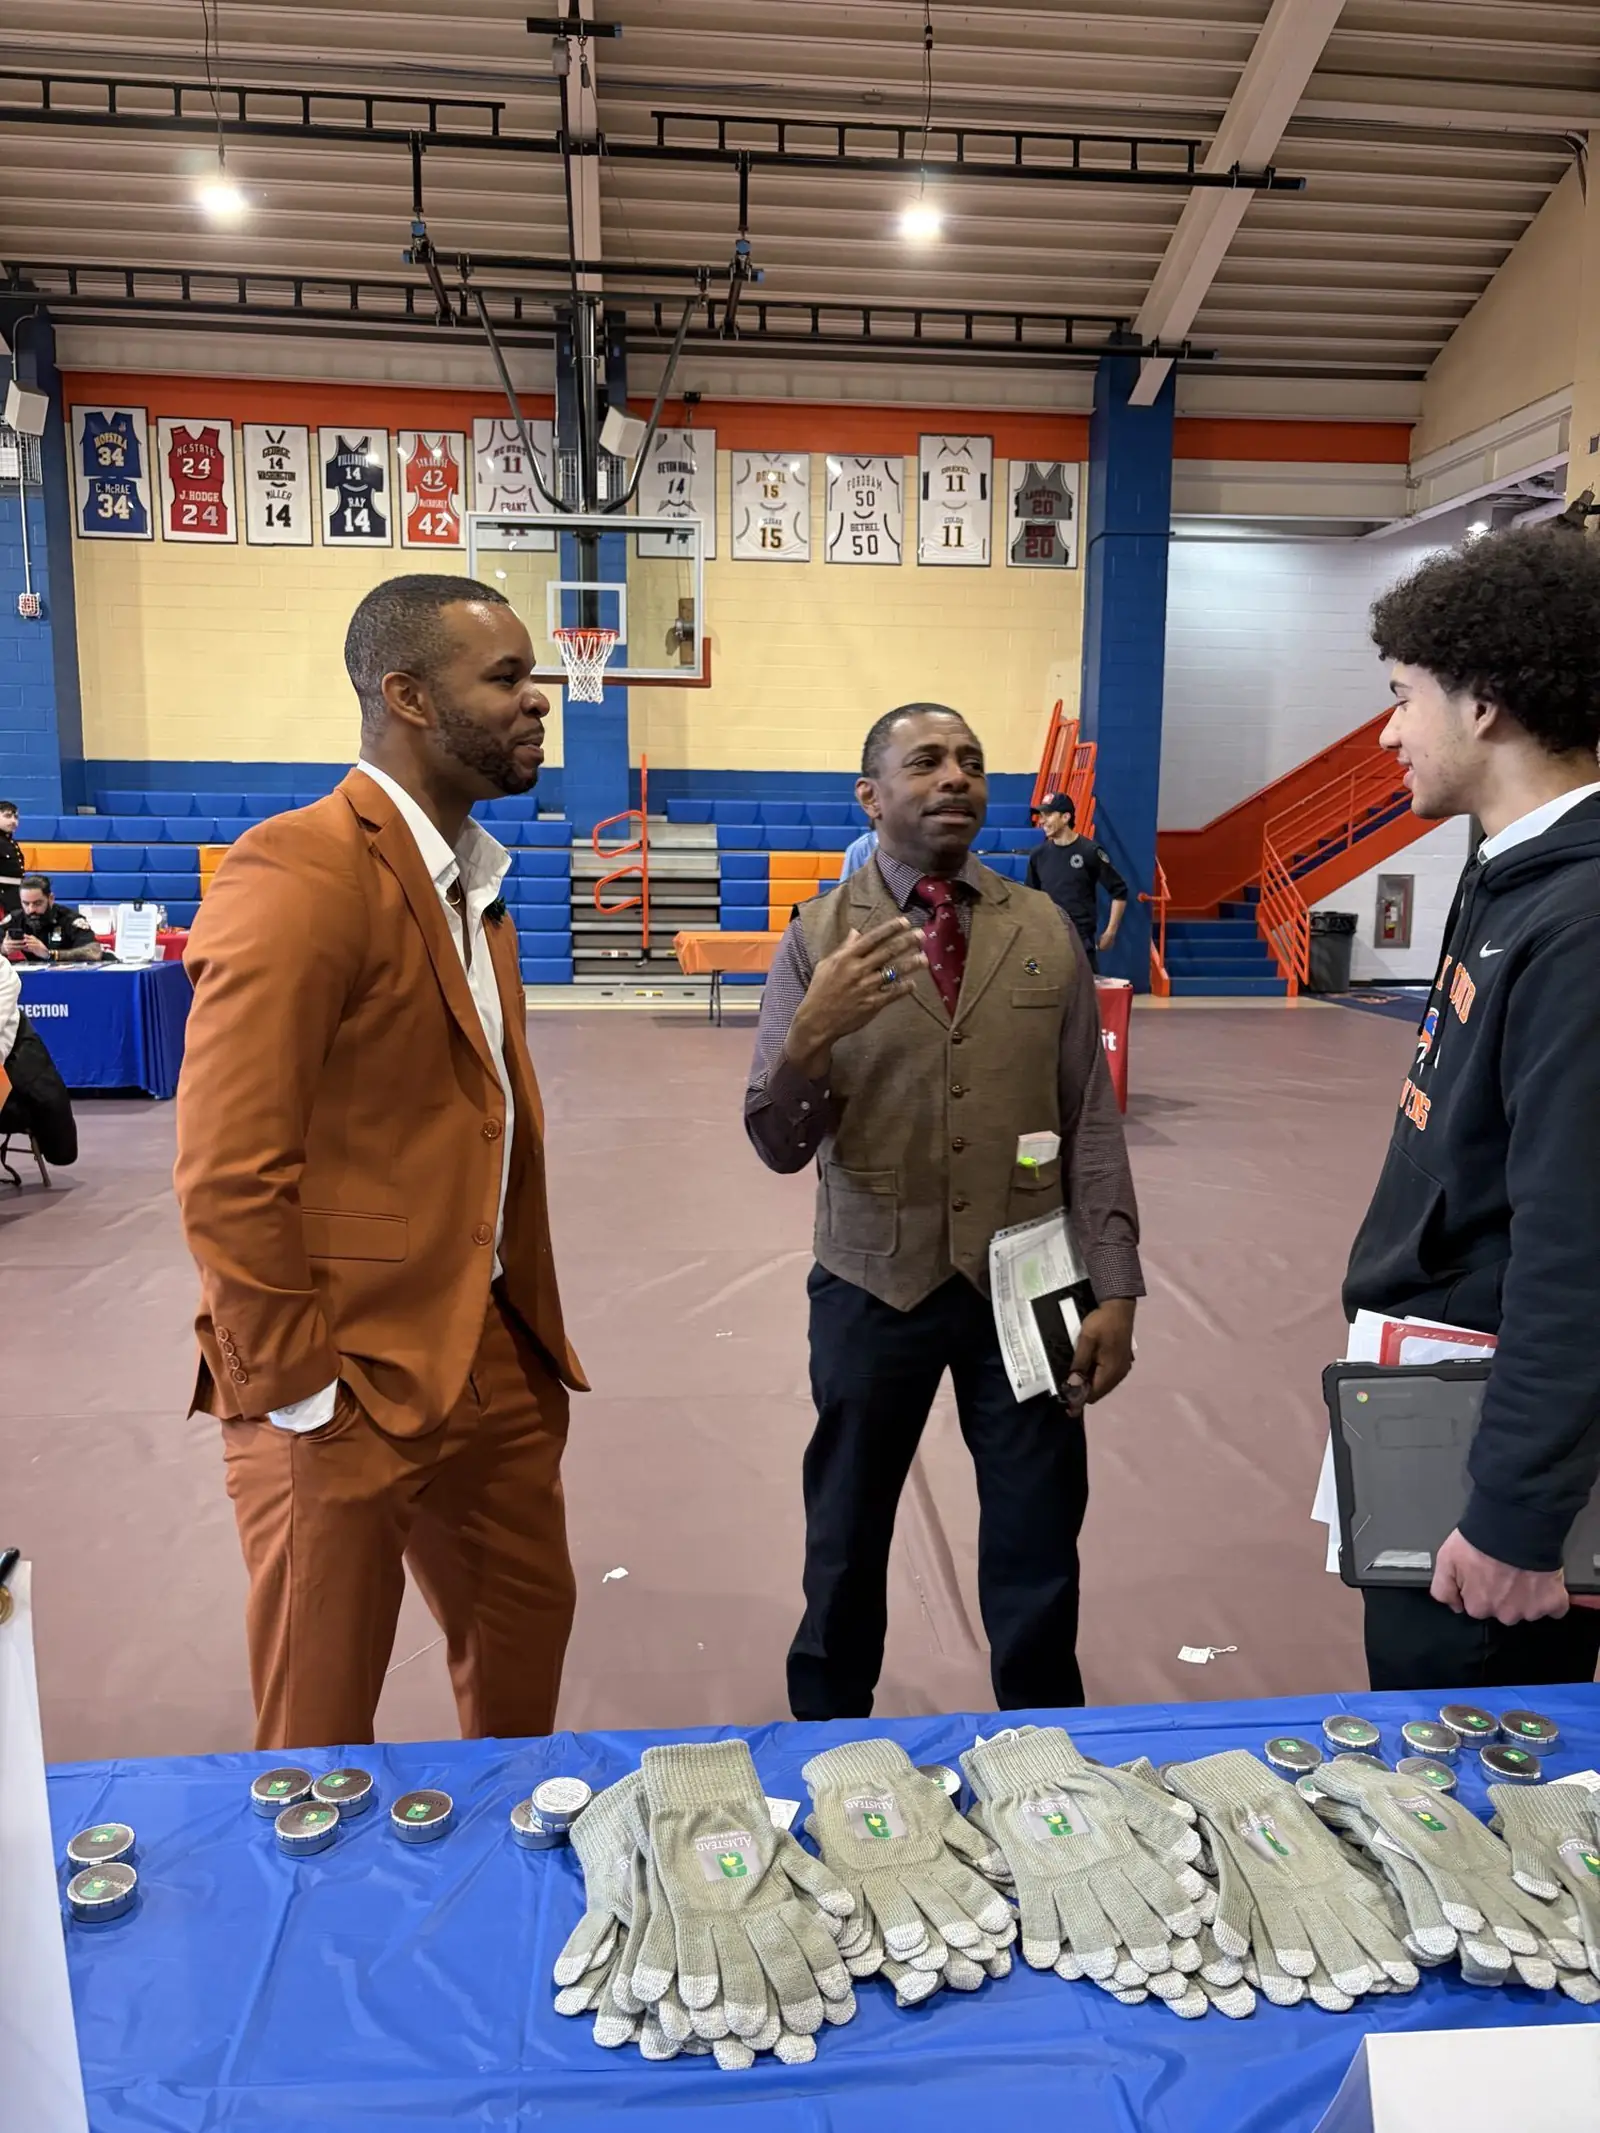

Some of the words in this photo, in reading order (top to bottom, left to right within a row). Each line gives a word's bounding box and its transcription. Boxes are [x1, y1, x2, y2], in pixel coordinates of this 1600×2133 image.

[98, 447, 124, 467] 34
[189, 443, 216, 459] STATE
[262, 445, 290, 459] GEORGE
[182, 458, 211, 474] 24
[269, 457, 283, 469] 14
[502, 456, 523, 474] 11
[257, 470, 297, 481] WASHINGTON
[345, 466, 361, 480] 14
[422, 470, 444, 486] 42
[668, 478, 685, 494] 14
[763, 485, 779, 498] 15
[946, 475, 966, 492] 11
[190, 491, 220, 502] HODGE
[266, 490, 292, 501] MILLER
[348, 497, 366, 508] RAY
[855, 491, 875, 507] 50
[97, 494, 130, 520] 34
[182, 503, 219, 526] 24
[1032, 500, 1053, 515] 20
[265, 503, 291, 528] 14
[343, 508, 371, 532] 14
[418, 512, 448, 536] 42
[760, 527, 782, 549] 15
[942, 526, 965, 548] 11
[852, 535, 878, 556] 50
[1025, 537, 1053, 558] 20
[846, 1799, 893, 1812] ALMSTEAD
[695, 1835, 752, 1852] ALMSTEAD
